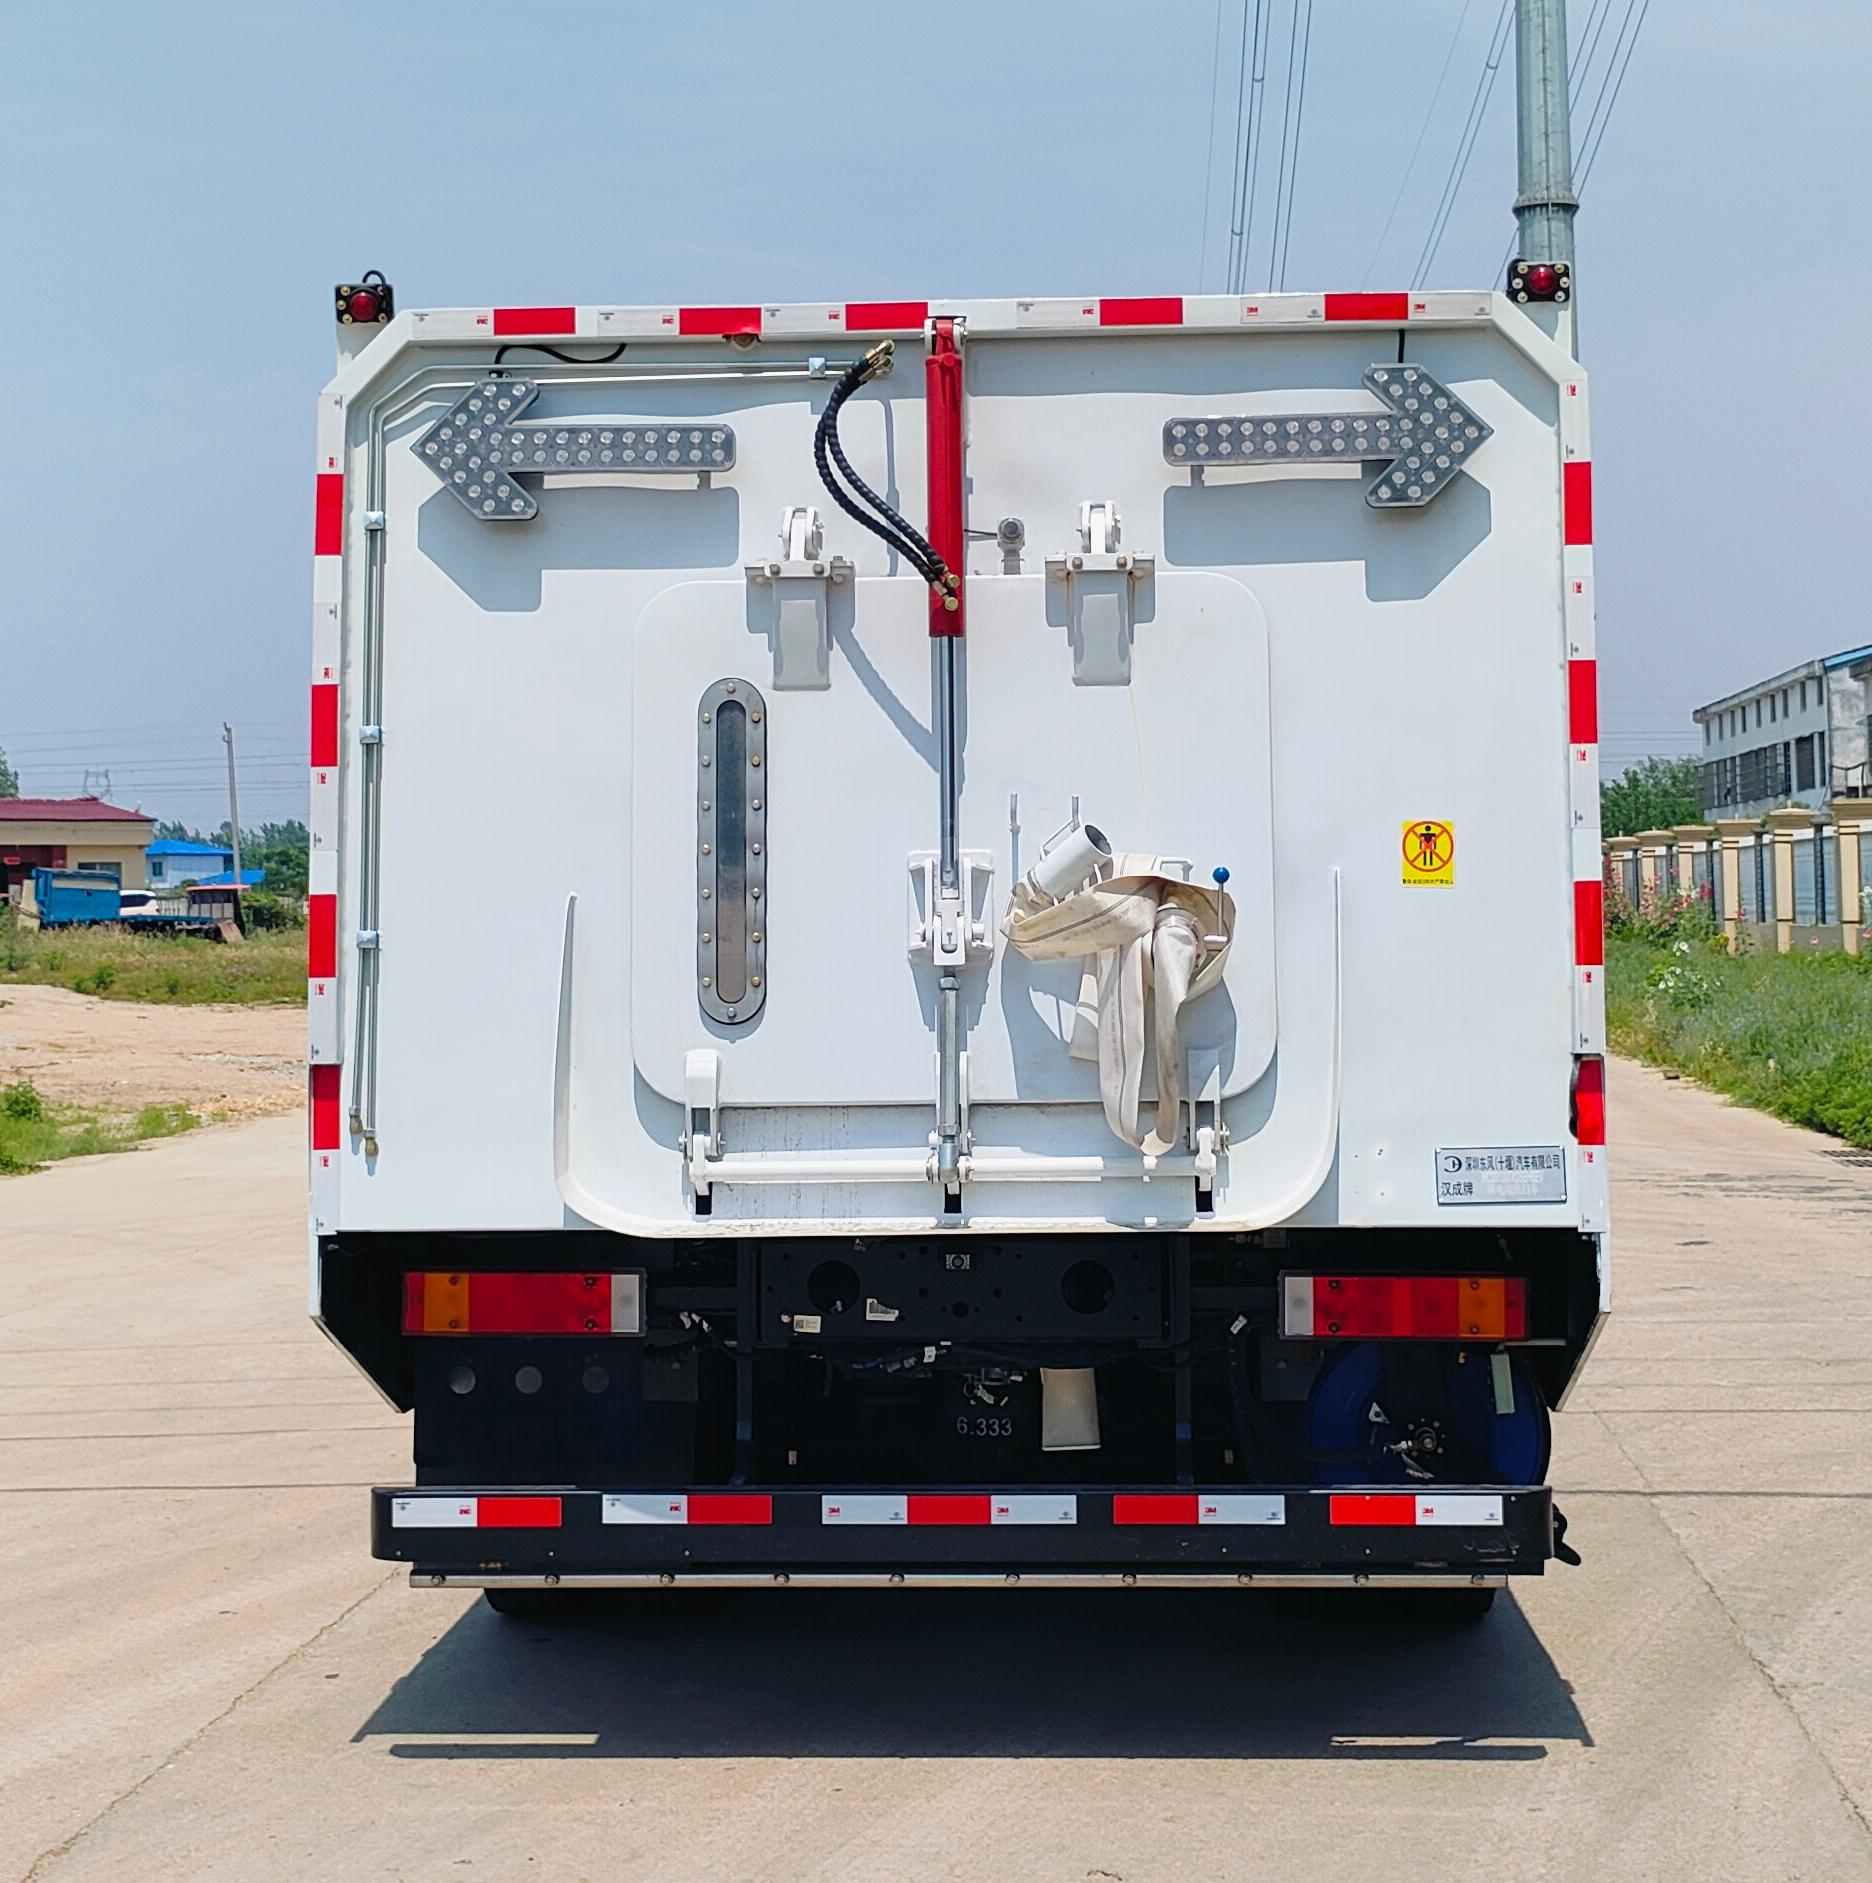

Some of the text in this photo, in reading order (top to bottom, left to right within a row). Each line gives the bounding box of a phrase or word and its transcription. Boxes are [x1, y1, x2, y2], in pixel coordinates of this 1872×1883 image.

[1441, 1181, 1474, 1197] 汉成牌
[956, 1416, 1012, 1436] 6.333
